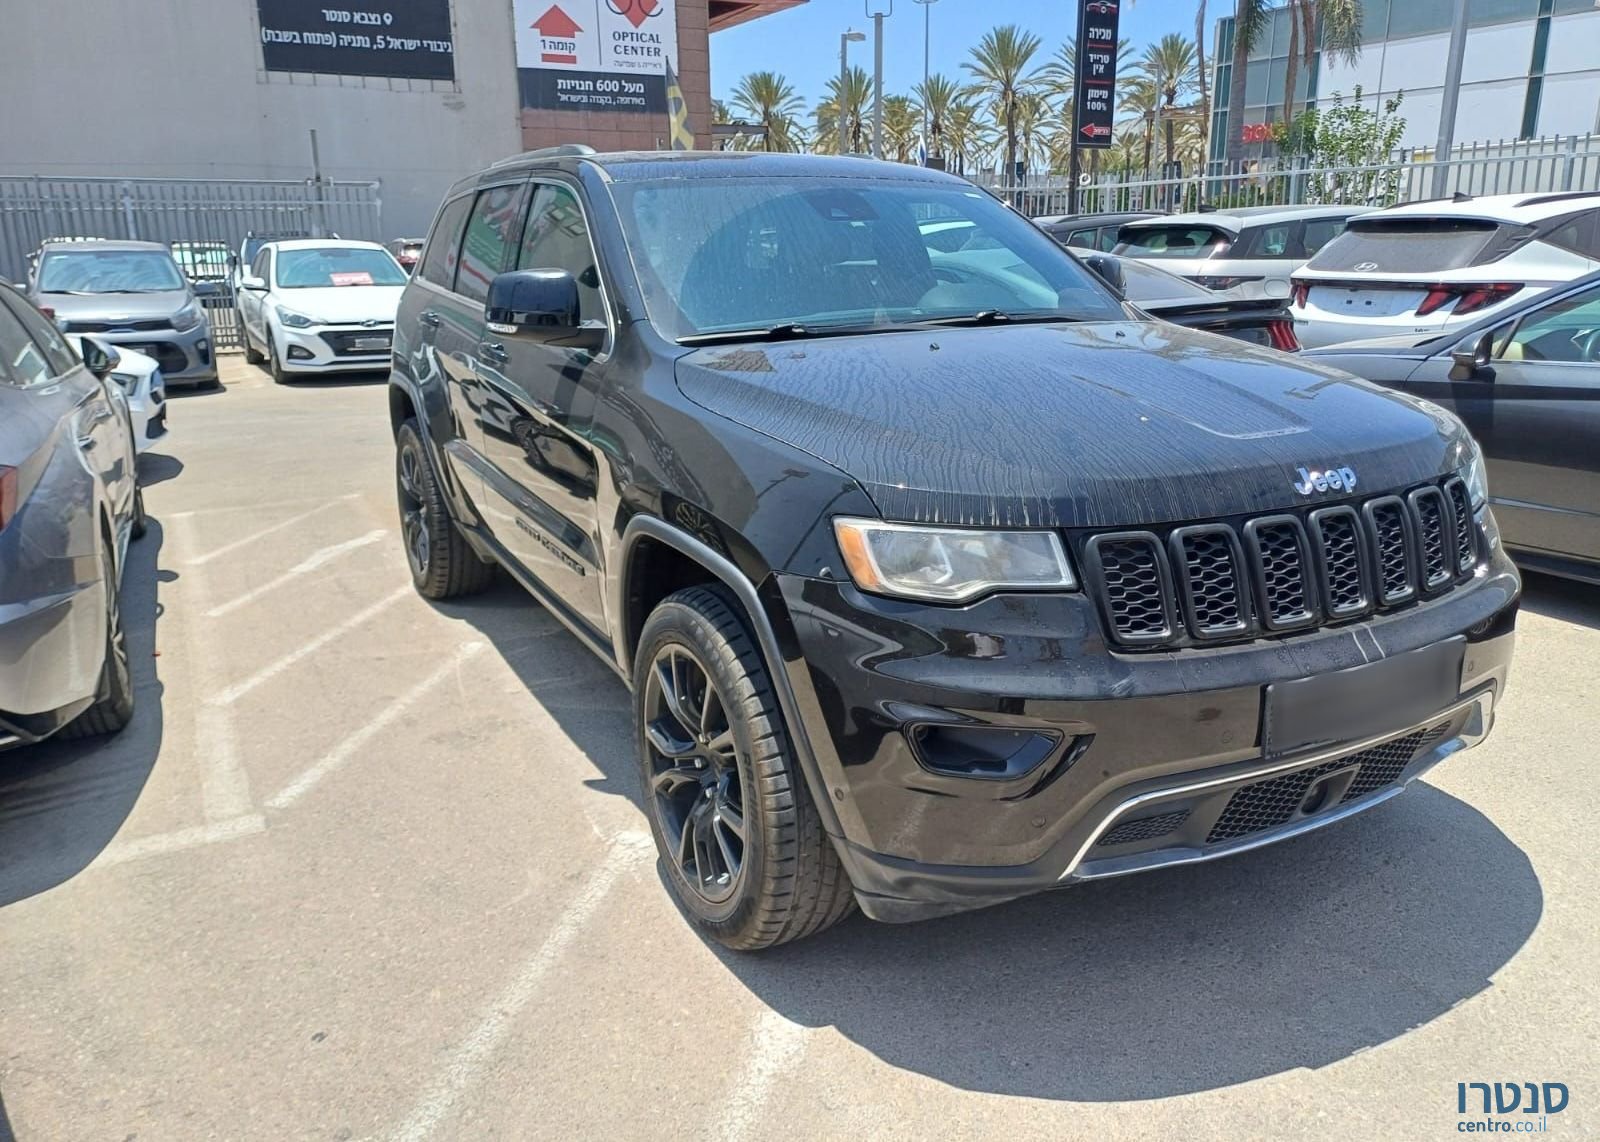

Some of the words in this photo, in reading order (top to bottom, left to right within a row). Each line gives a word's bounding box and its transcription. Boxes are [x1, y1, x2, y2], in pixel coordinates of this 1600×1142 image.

[354, 13, 381, 25] נצבא
[612, 30, 662, 44] OPTICAL
[1088, 27, 1112, 40] מכירה
[339, 33, 371, 48] נתניה
[386, 35, 421, 50] ישראל
[540, 39, 547, 50] 1
[549, 40, 576, 54] קומה
[613, 44, 662, 57] CENTER
[557, 79, 594, 91] חנויות
[596, 79, 620, 92] 600
[621, 80, 645, 93] מעל
[1087, 88, 1109, 100] מימון
[1086, 101, 1107, 111] 100%
[1294, 467, 1357, 495] Jeep
